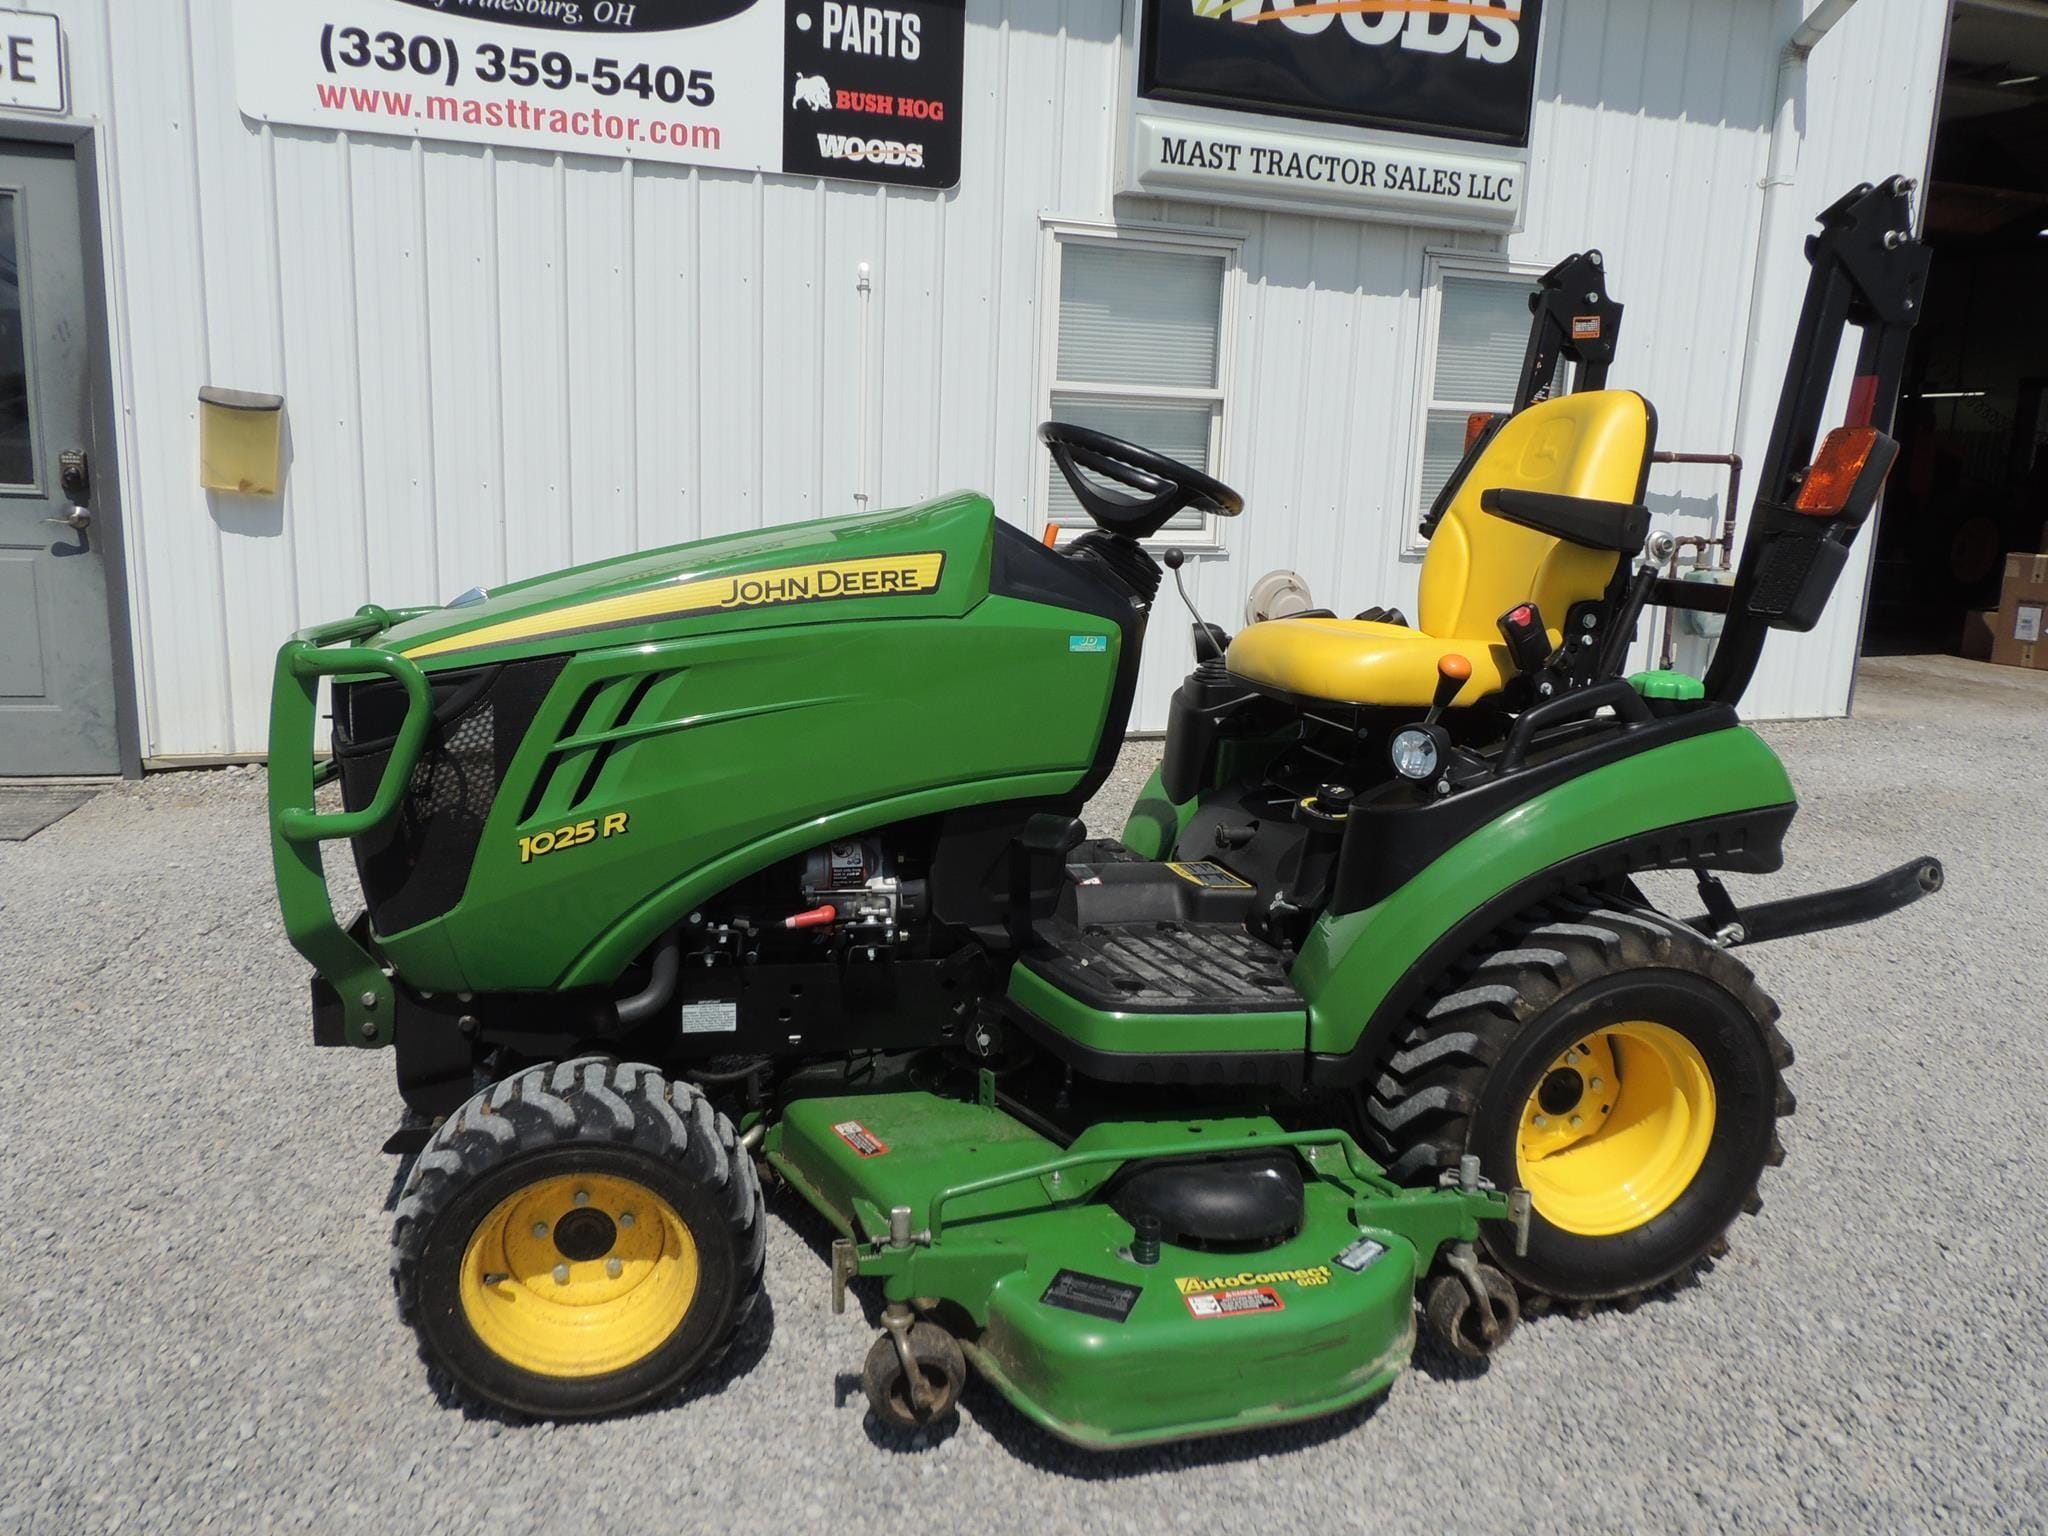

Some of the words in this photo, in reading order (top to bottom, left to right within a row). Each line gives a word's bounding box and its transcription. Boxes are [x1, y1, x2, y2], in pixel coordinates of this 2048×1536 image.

[593, 0, 636, 27] OH
[822, 1, 921, 60] PARTS
[319, 23, 460, 86] (330)
[474, 43, 715, 107] 359-5405
[316, 83, 721, 150] www.masttractor.com
[835, 89, 893, 116] BUSH
[897, 97, 944, 121] HOG
[816, 132, 925, 169] WOODS
[1160, 136, 1241, 172] MAST
[1250, 147, 1376, 187] TRACTOR
[1383, 163, 1462, 197] SALES
[1467, 174, 1514, 202] LLC
[720, 576, 809, 604] JOHN
[817, 568, 918, 594] DEERE
[519, 819, 598, 864] 1025
[603, 811, 629, 838] R
[1175, 1265, 1332, 1294] AutoConnect
